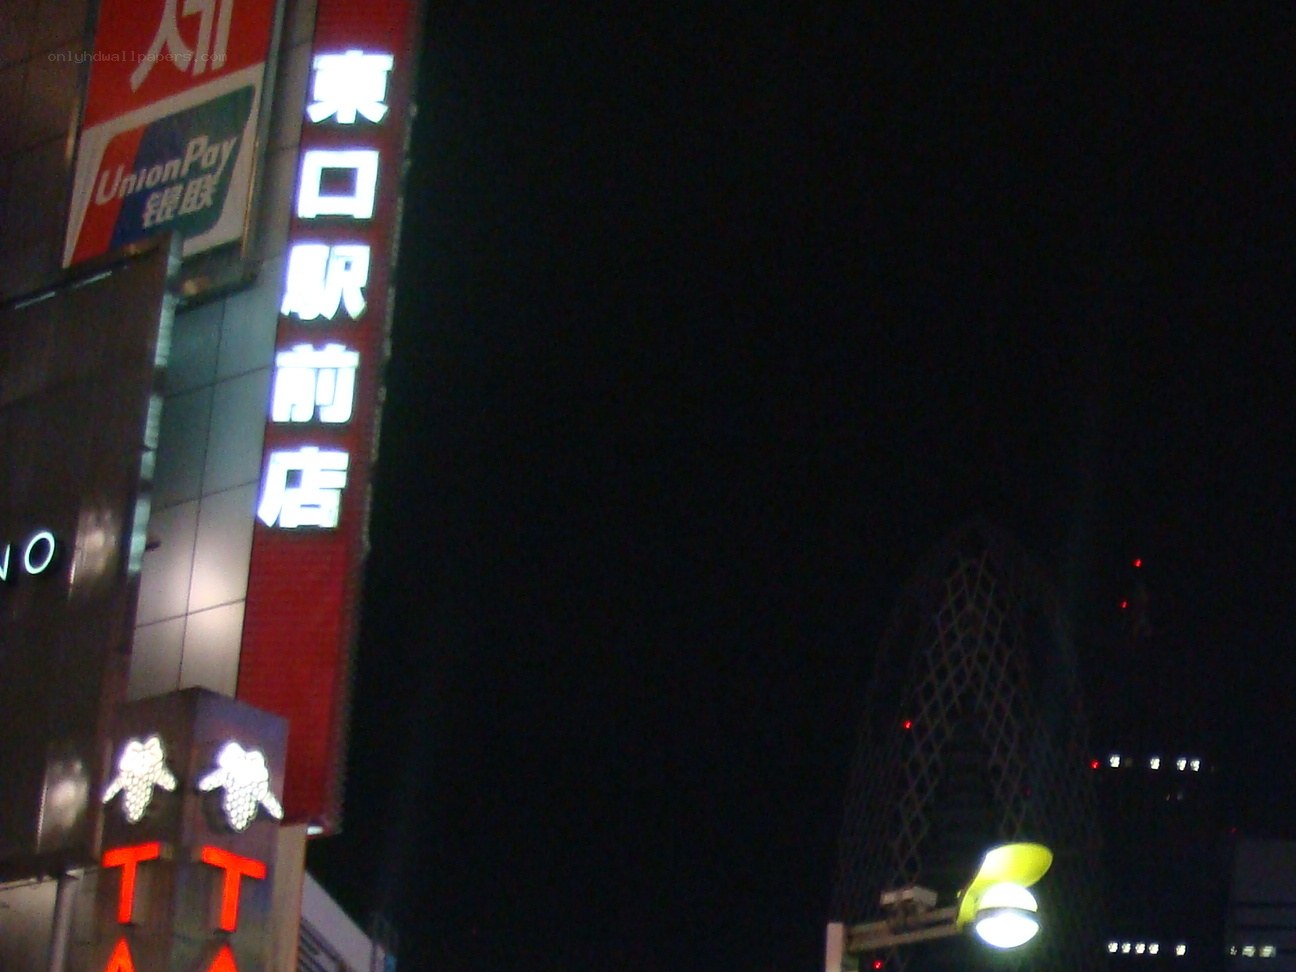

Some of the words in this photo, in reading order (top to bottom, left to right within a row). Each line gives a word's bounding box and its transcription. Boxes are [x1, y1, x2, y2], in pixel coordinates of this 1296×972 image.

[95, 135, 238, 206] UnionPay
[257, 50, 395, 529] 東口駅前店
